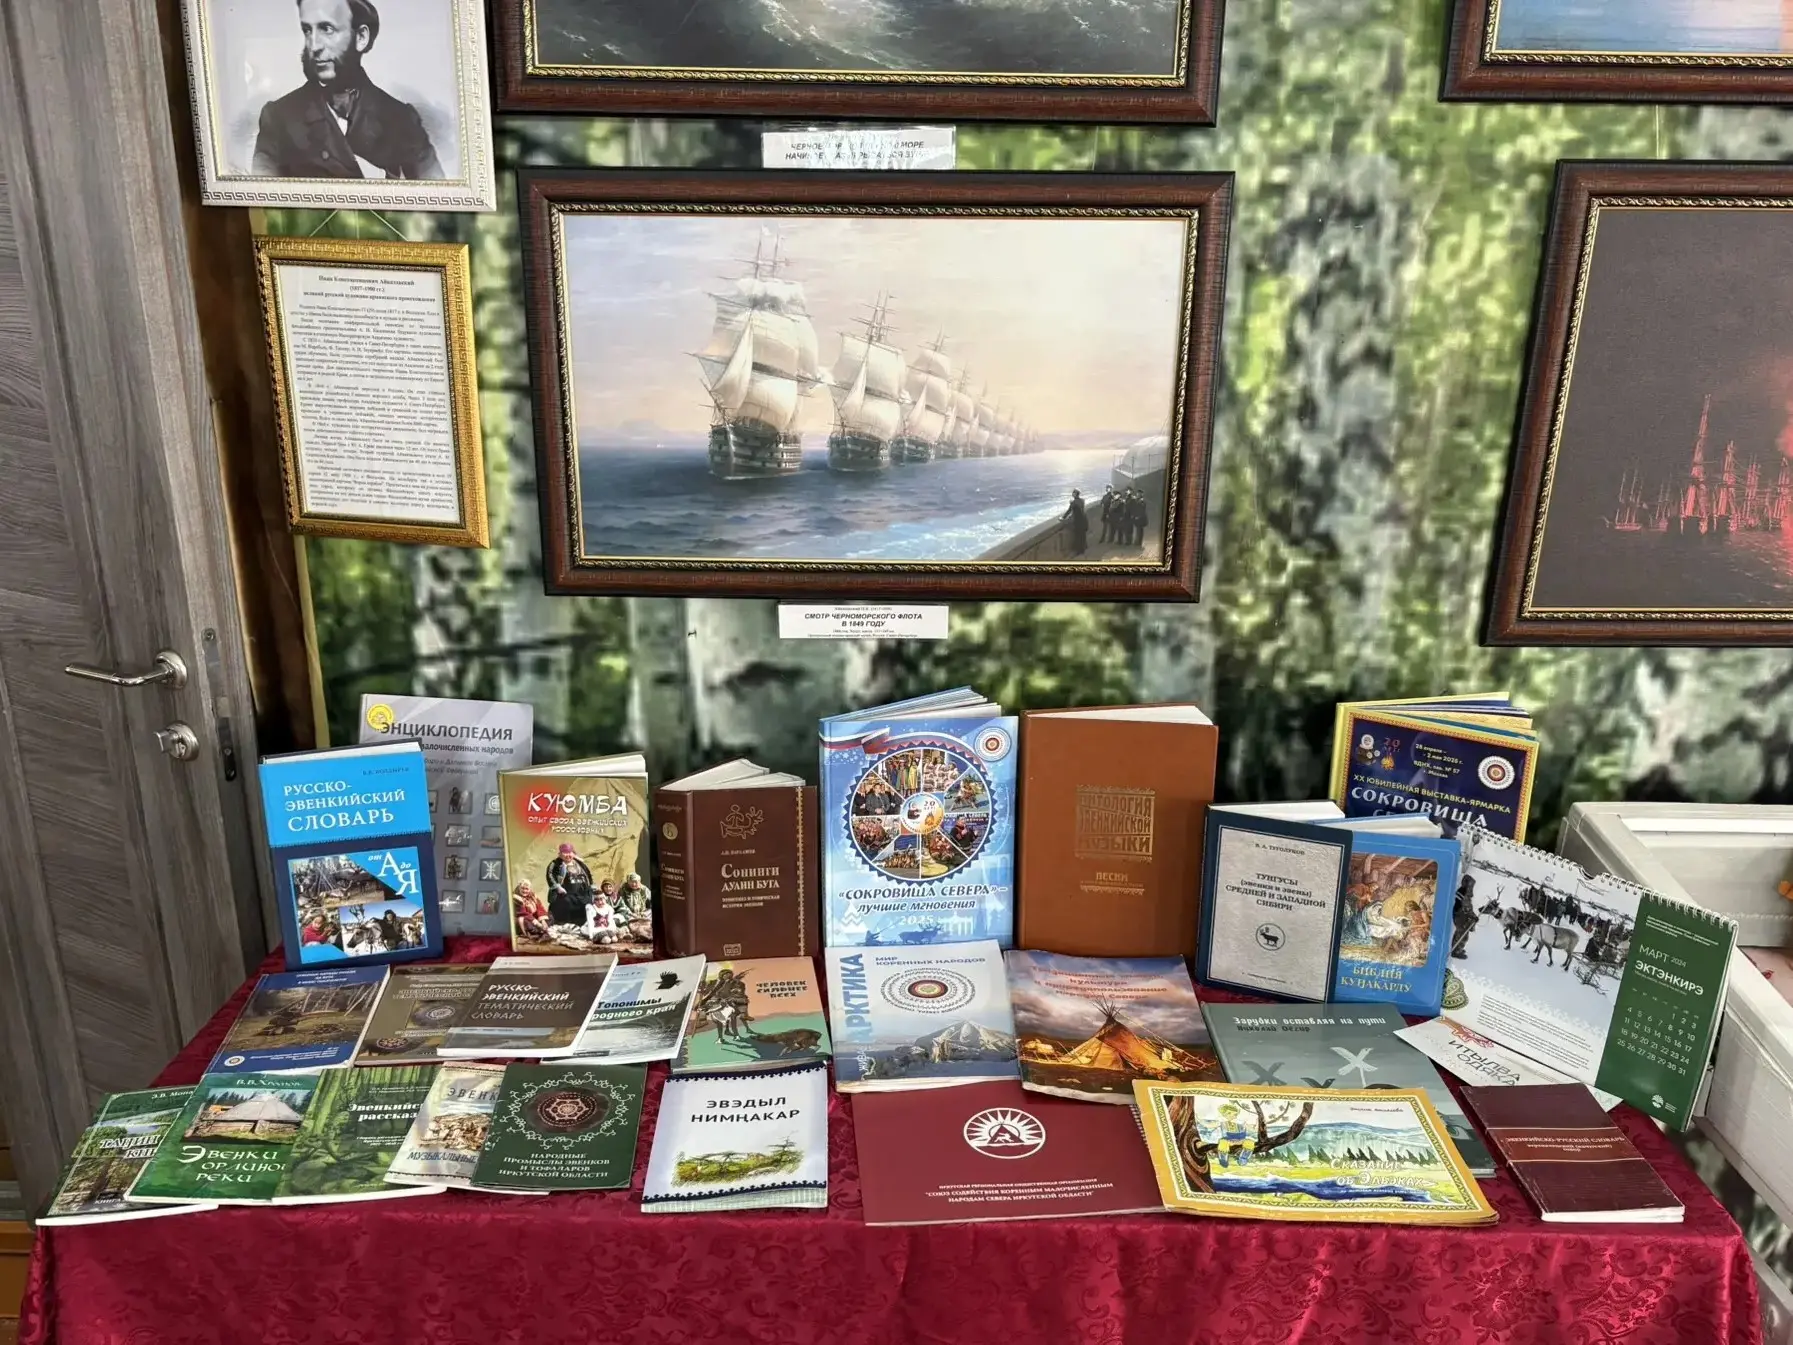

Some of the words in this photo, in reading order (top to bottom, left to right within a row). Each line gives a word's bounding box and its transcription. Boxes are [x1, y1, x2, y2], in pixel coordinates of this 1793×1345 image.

[380, 722, 513, 741] ЭНЦИКЛОПЕДИЯ
[482, 746, 514, 755] народов
[284, 780, 352, 797] РУССКО-
[1366, 776, 1420, 794] ЮБИЛЕЙНАЯ
[1421, 788, 1511, 814] ВЫСТАВКА-ЯРМАРКА
[285, 790, 406, 812] ЭВЕНКИЙСКИЙ
[528, 792, 628, 815] КУЮМБА
[1351, 787, 1488, 827] СОКРОВИЩА
[288, 810, 394, 832] СЛОВАРЬ
[378, 852, 400, 878] А
[400, 861, 412, 870] до
[396, 869, 420, 896] Я
[1096, 872, 1128, 881] ПЕСНИ
[1256, 873, 1298, 886] ТУНГУСЫ
[721, 880, 754, 892] ДУЛИН
[756, 879, 780, 889] БУГА
[838, 886, 936, 901] «СОКРОВИЩА
[940, 884, 997, 896] СЕВЕРА»
[1240, 879, 1273, 890] (эвенки
[1282, 887, 1312, 898] эвены)
[1226, 884, 1267, 898] СРЕДНЕЙ
[1276, 893, 1326, 908] ЗАПАДНОЙ
[857, 901, 906, 915] лучшие
[910, 900, 976, 911] мгновения
[1256, 899, 1293, 911] СИБИРИ
[1639, 944, 1670, 962] МАРТ
[1353, 966, 1402, 979] БИБЛИЯ
[1635, 960, 1704, 995] ЭКТЭНКИРЭ
[482, 992, 570, 1000] ЭВЕНКИЙСКИЙ
[597, 998, 662, 1008] Топонимы
[840, 953, 875, 1044] АРКТИКА
[478, 1001, 574, 1010] ТЕМАТИЧЕСКИЙ
[592, 1010, 642, 1020] родного
[646, 1005, 676, 1015] края
[1233, 1017, 1277, 1026] Зарубки
[1358, 1018, 1387, 1026] пути
[1687, 1033, 1696, 1041] 10
[1448, 1040, 1520, 1081] ИТЫЛВА
[1617, 1039, 1626, 1047] 25
[1627, 1043, 1636, 1052] 26
[1637, 1048, 1646, 1056] 27
[1647, 1052, 1656, 1061] 28
[1667, 1062, 1677, 1070] 30
[1678, 1067, 1686, 1076] 31
[1660, 1046, 1669, 1054] 22
[1670, 1051, 1679, 1059] 23
[1681, 1056, 1690, 1064] 24
[706, 1097, 786, 1108] ЭВЭДЫЛ
[407, 1152, 478, 1164] МУЗЫКАЛЬНЫЕ
[196, 1173, 252, 1183] РЕКИ
